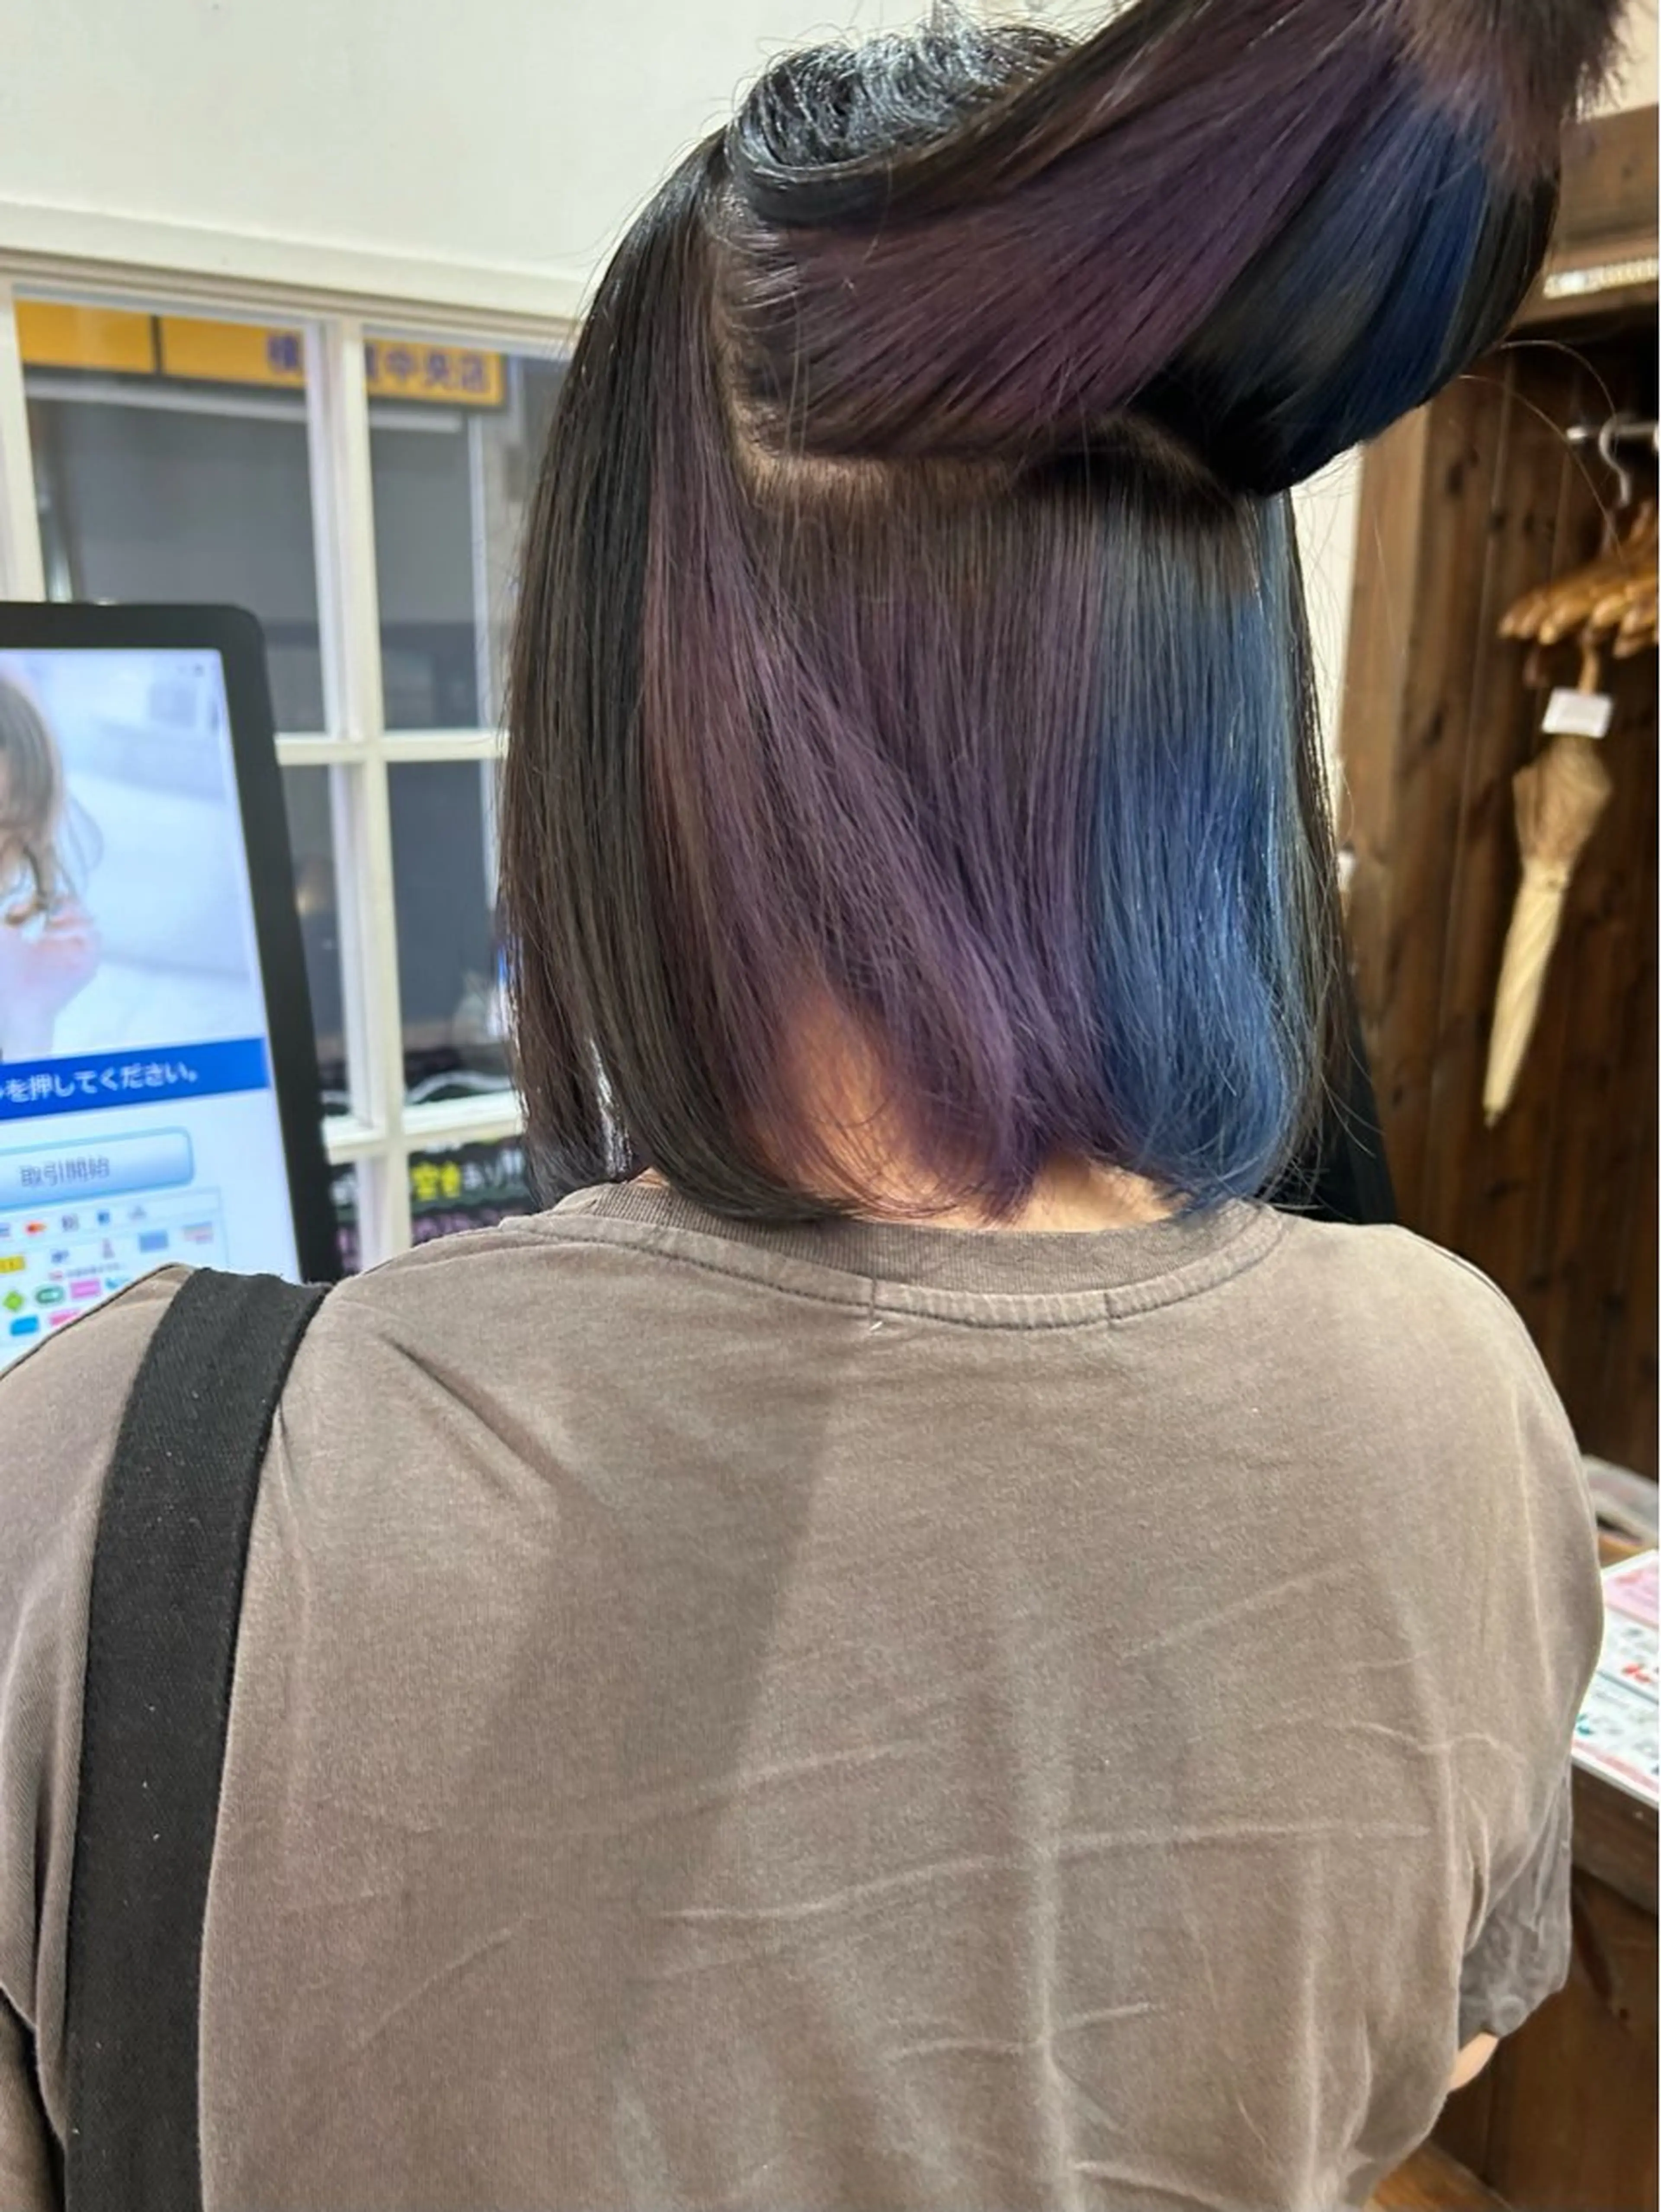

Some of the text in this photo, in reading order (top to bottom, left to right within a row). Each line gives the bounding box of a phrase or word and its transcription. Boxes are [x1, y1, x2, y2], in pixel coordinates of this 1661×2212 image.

[267, 332, 489, 393] 横中央店
[0, 1061, 198, 1103] を押してください。
[20, 1157, 110, 1188] 取引開始
